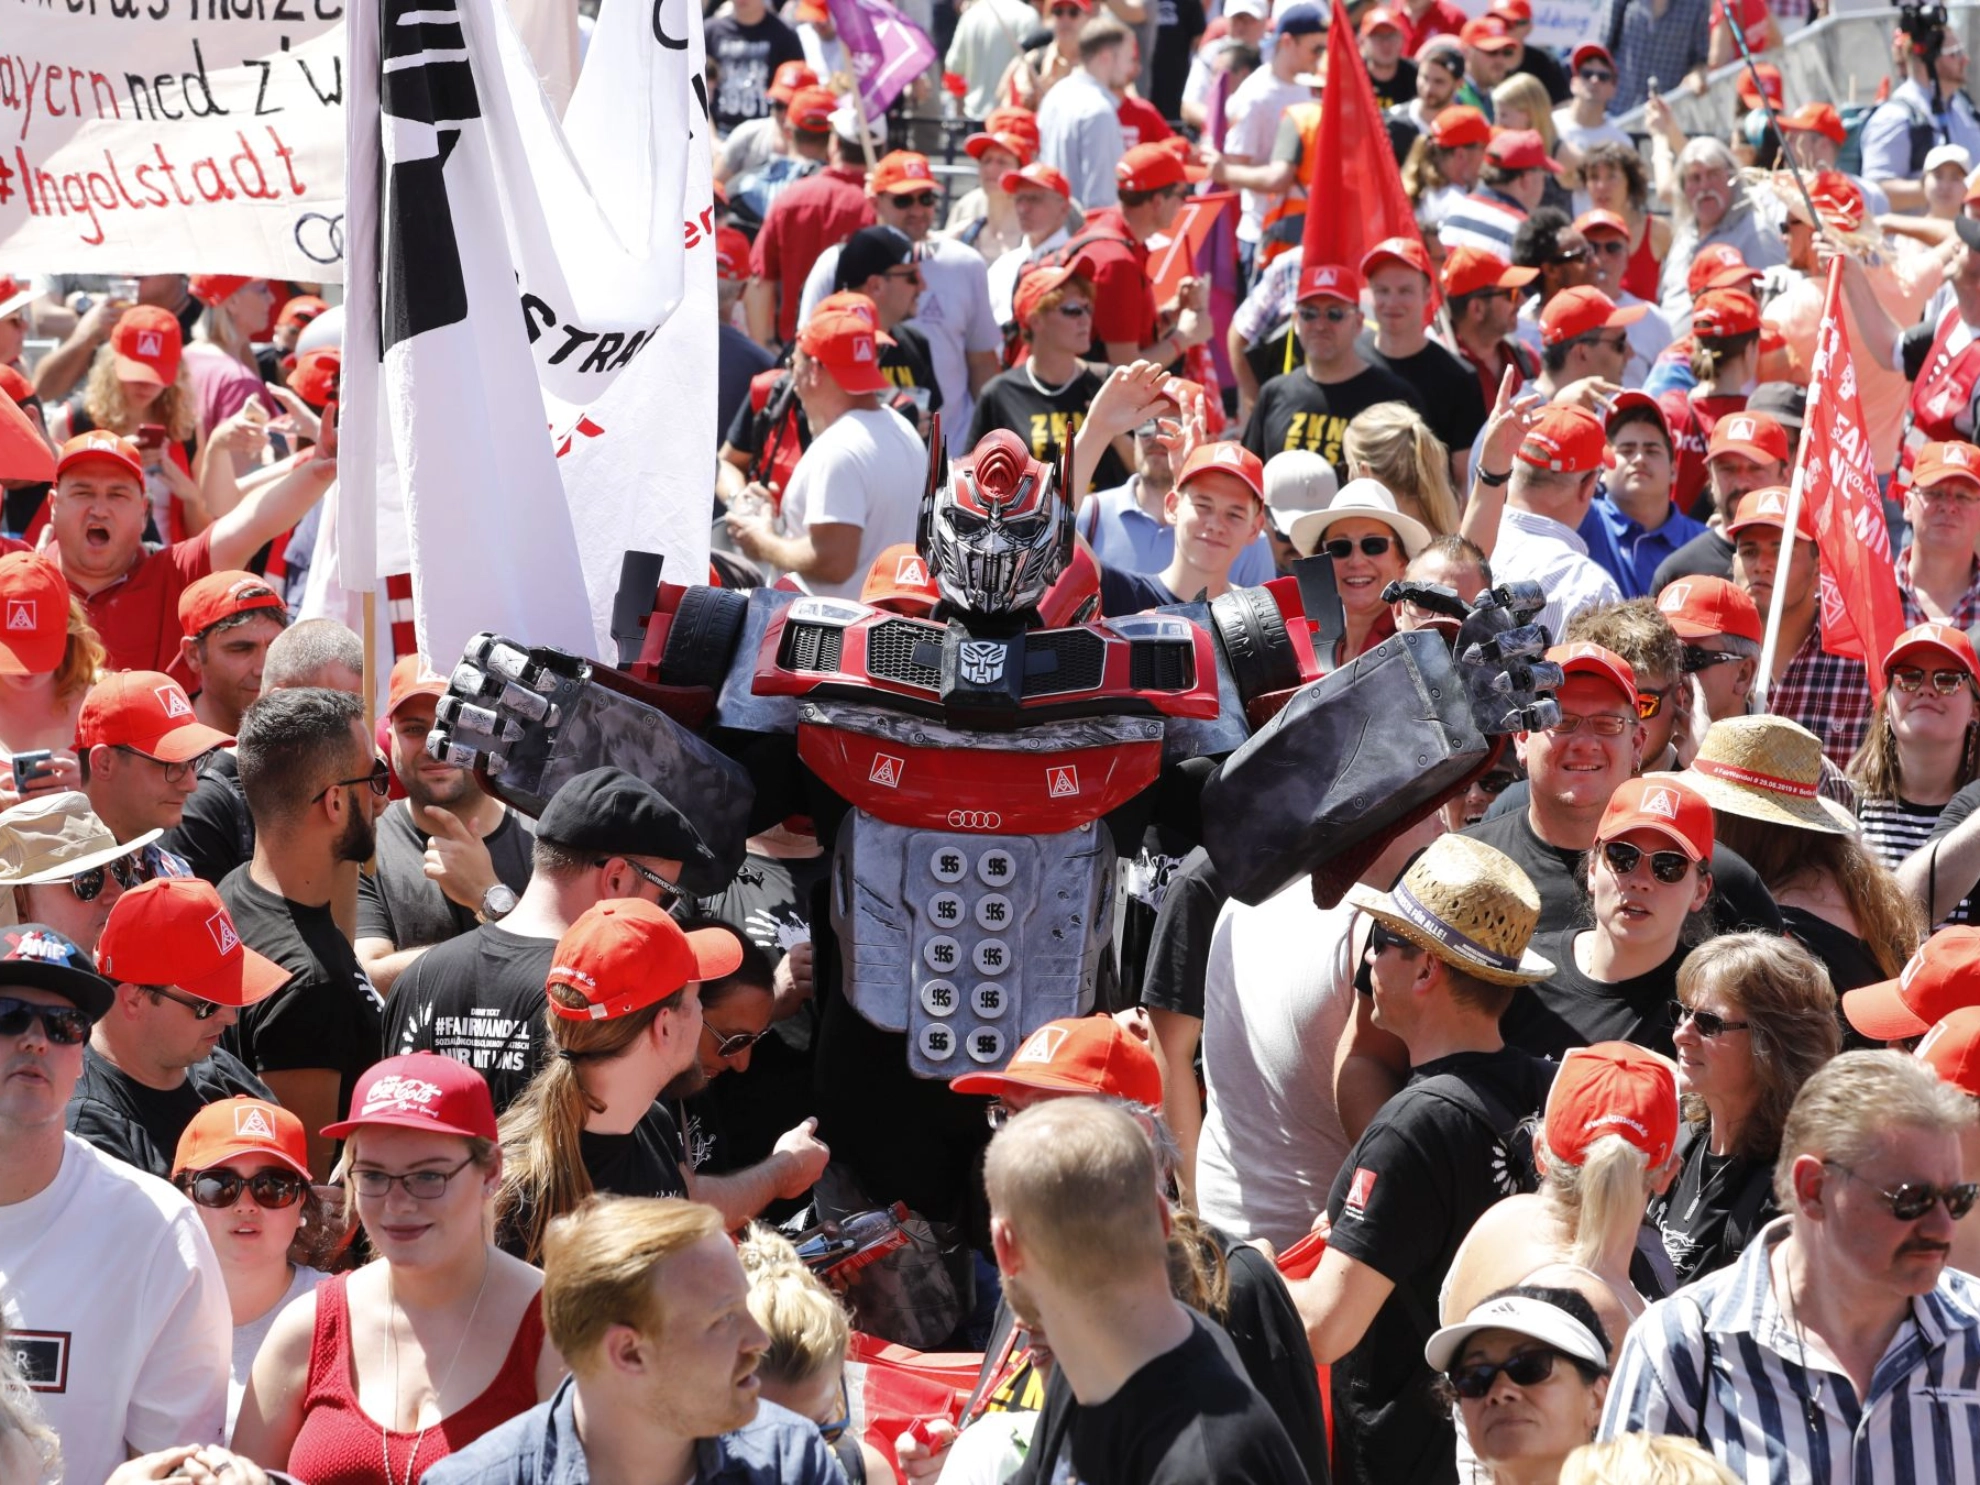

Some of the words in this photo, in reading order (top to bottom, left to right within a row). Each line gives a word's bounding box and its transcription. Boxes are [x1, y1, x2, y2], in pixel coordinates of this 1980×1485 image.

[124, 38, 229, 121] ned
[1286, 411, 1348, 443] ZKN
[1410, 909, 1427, 926] FÜR
[1423, 919, 1448, 941] ALLE!
